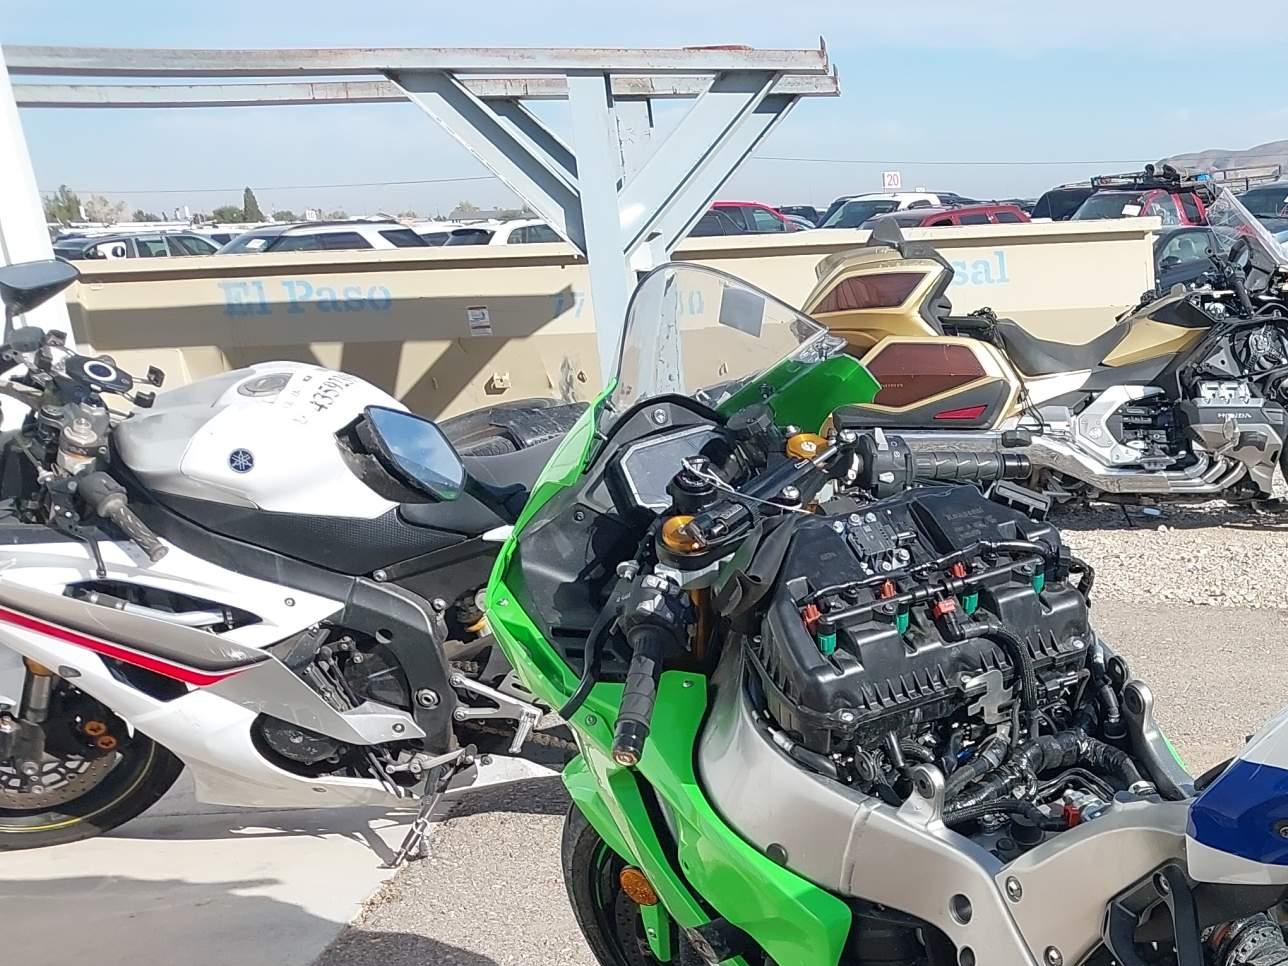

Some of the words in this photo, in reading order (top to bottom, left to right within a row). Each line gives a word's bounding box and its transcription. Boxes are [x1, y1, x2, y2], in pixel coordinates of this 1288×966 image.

[886, 173, 899, 187] 20
[218, 281, 273, 316] El
[281, 280, 393, 314] Paso
